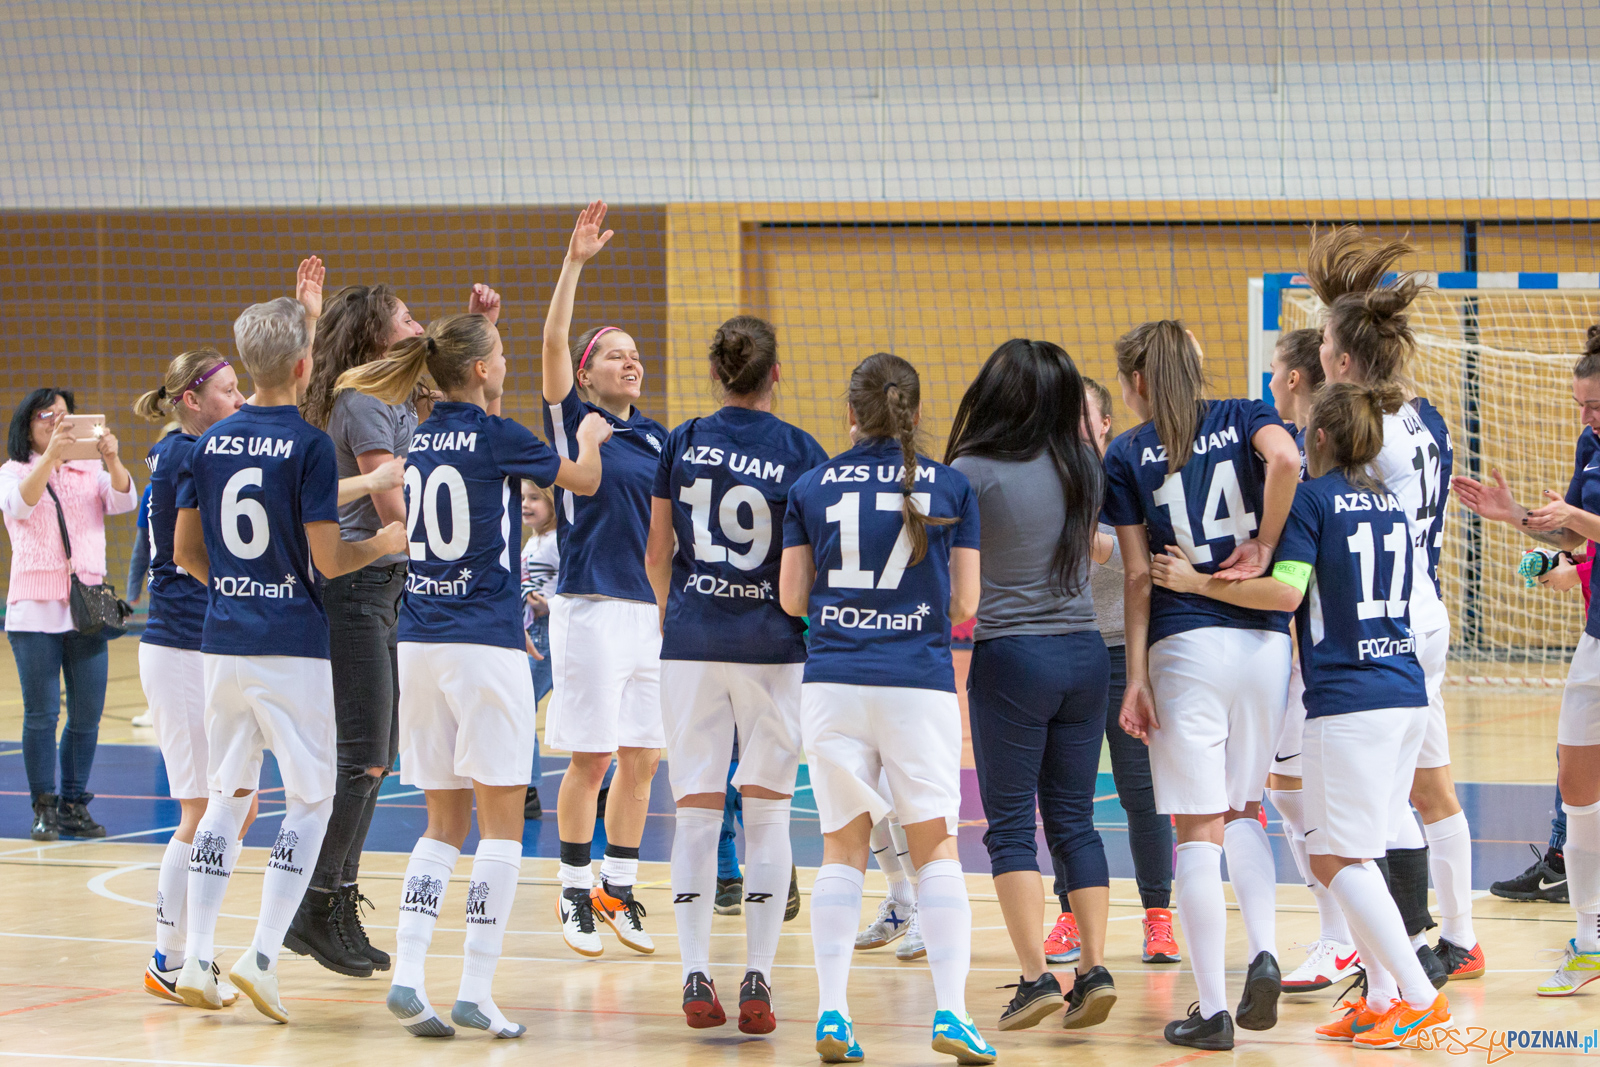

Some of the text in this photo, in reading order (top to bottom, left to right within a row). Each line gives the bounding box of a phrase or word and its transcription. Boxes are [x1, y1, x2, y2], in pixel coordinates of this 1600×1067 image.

[204, 436, 294, 458] AZS UAM
[432, 432, 477, 452] UAM
[1140, 426, 1239, 467] AZ UAM
[682, 446, 785, 483] AZS UAM
[820, 465, 870, 485] AZS
[1411, 442, 1440, 521] 12
[220, 467, 270, 560] 6
[403, 464, 471, 562] 20
[1153, 459, 1258, 565] 14
[1334, 493, 1404, 514] AZS UA
[679, 477, 772, 571] 19
[825, 492, 931, 590] 17
[1346, 522, 1408, 621] 11
[191, 847, 223, 868] UAM
[270, 847, 294, 863] AM
[273, 861, 303, 875] Kobiet
[404, 891, 439, 910] UAM
[466, 900, 486, 915] AM
[470, 916, 497, 925] Kobiet
